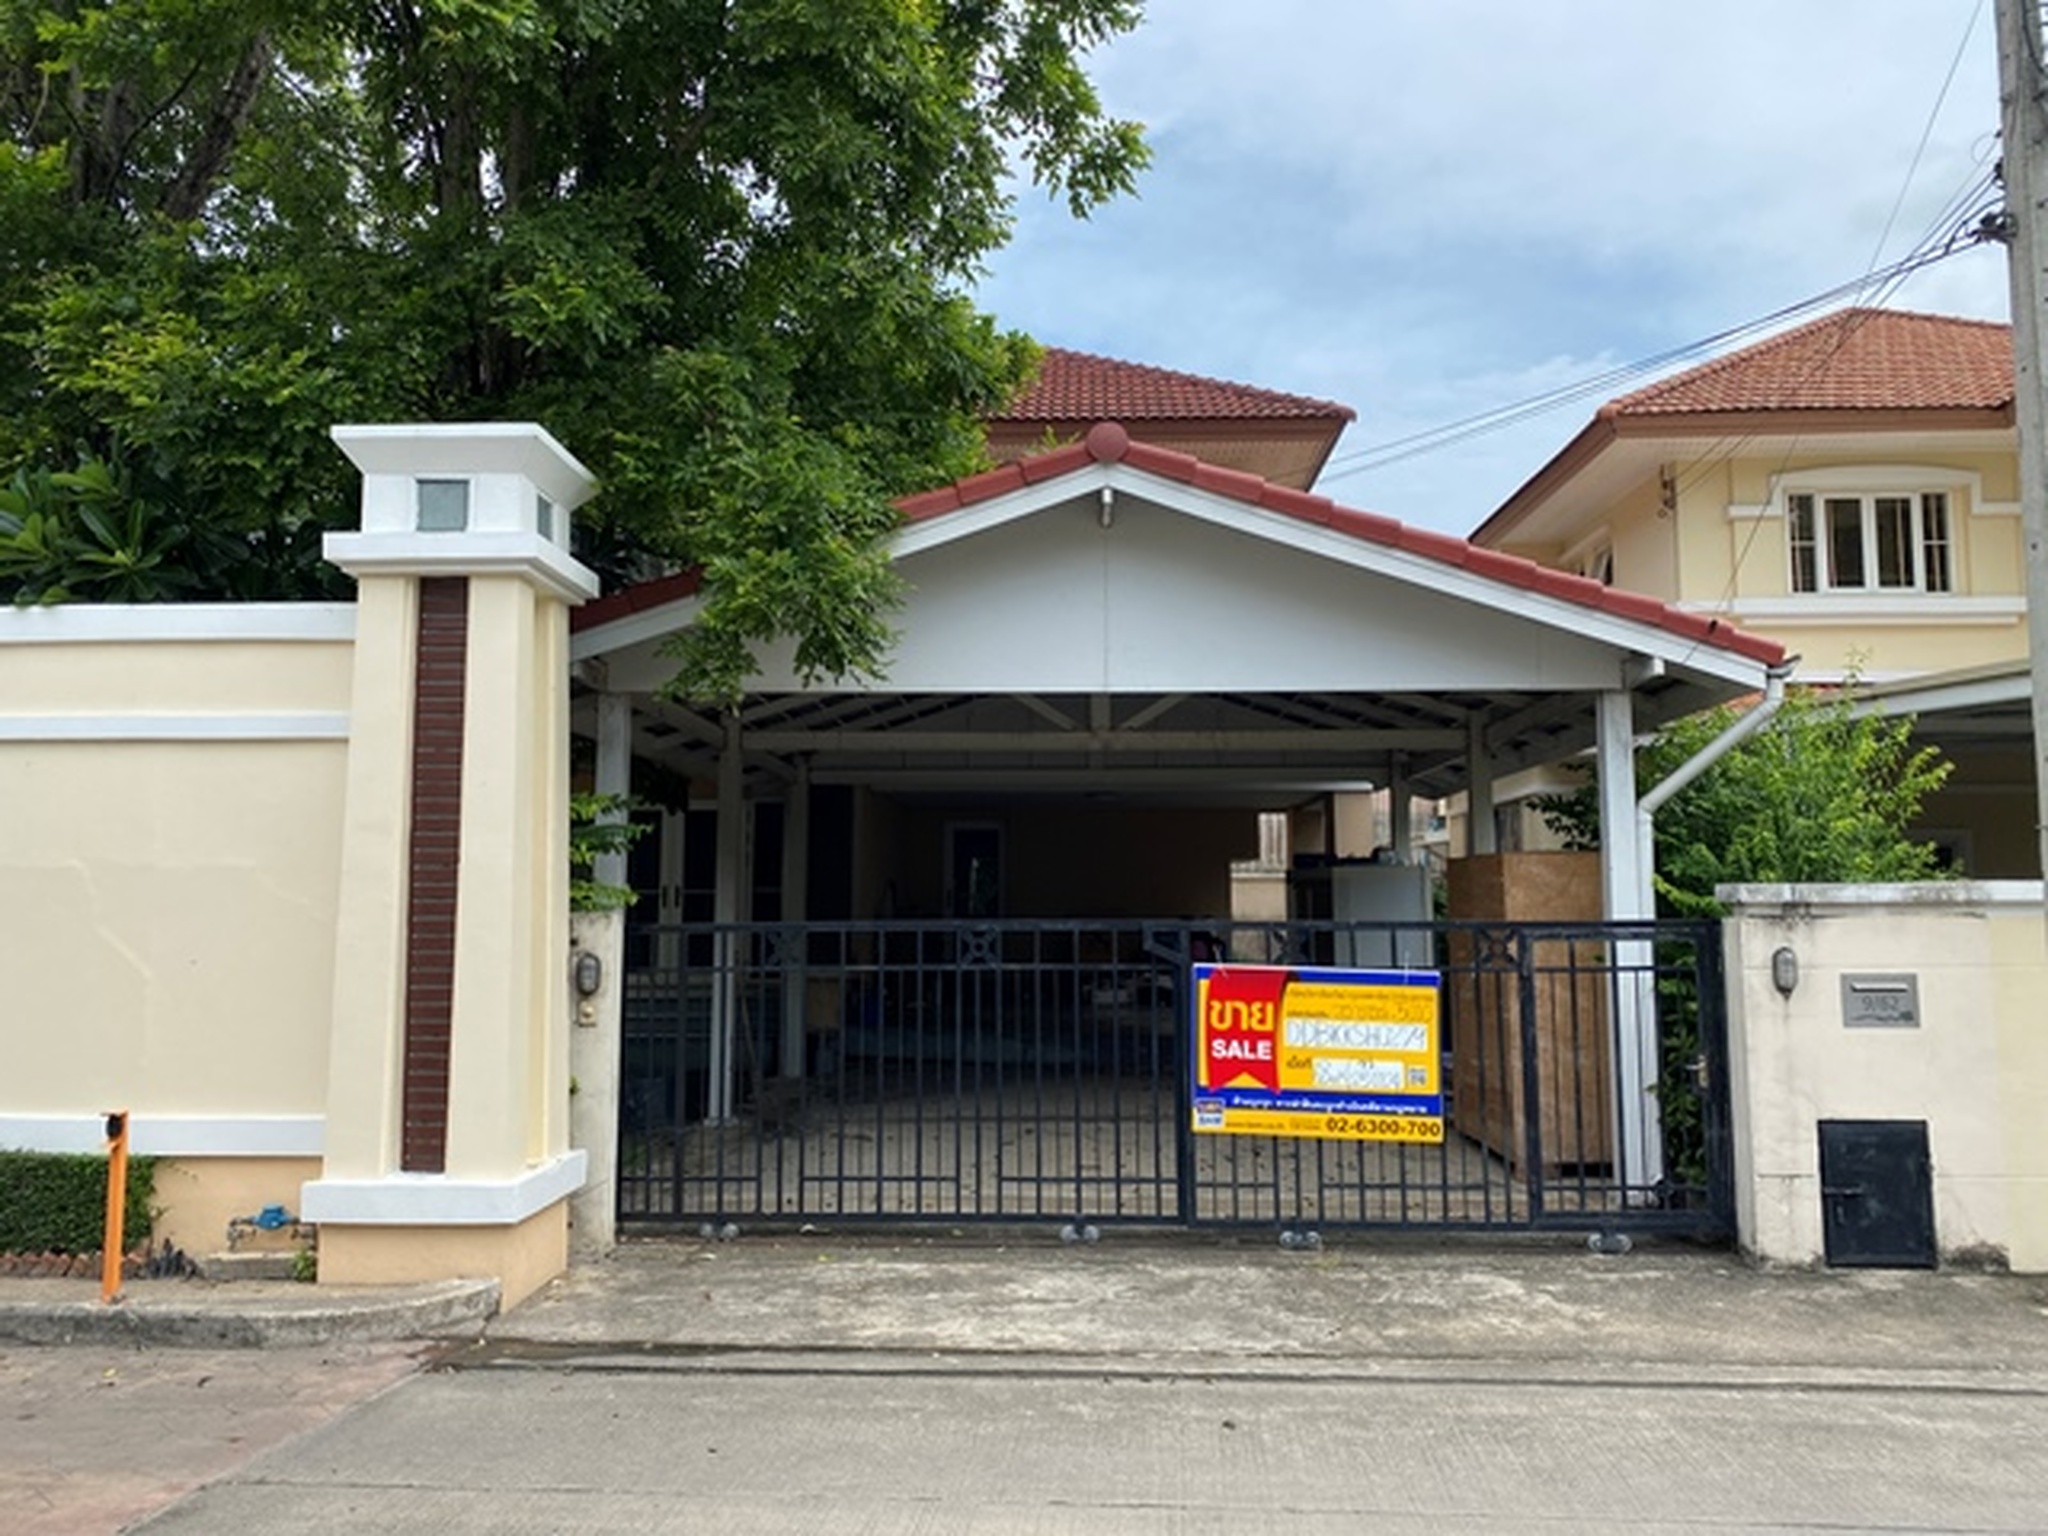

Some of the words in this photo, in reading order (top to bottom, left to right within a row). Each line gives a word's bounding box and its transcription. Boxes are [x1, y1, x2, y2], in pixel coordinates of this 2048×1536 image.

[1210, 1000, 1274, 1031] ขาย
[1211, 1039, 1272, 1060] SALE
[1326, 1117, 1441, 1137] 02-6300-700
